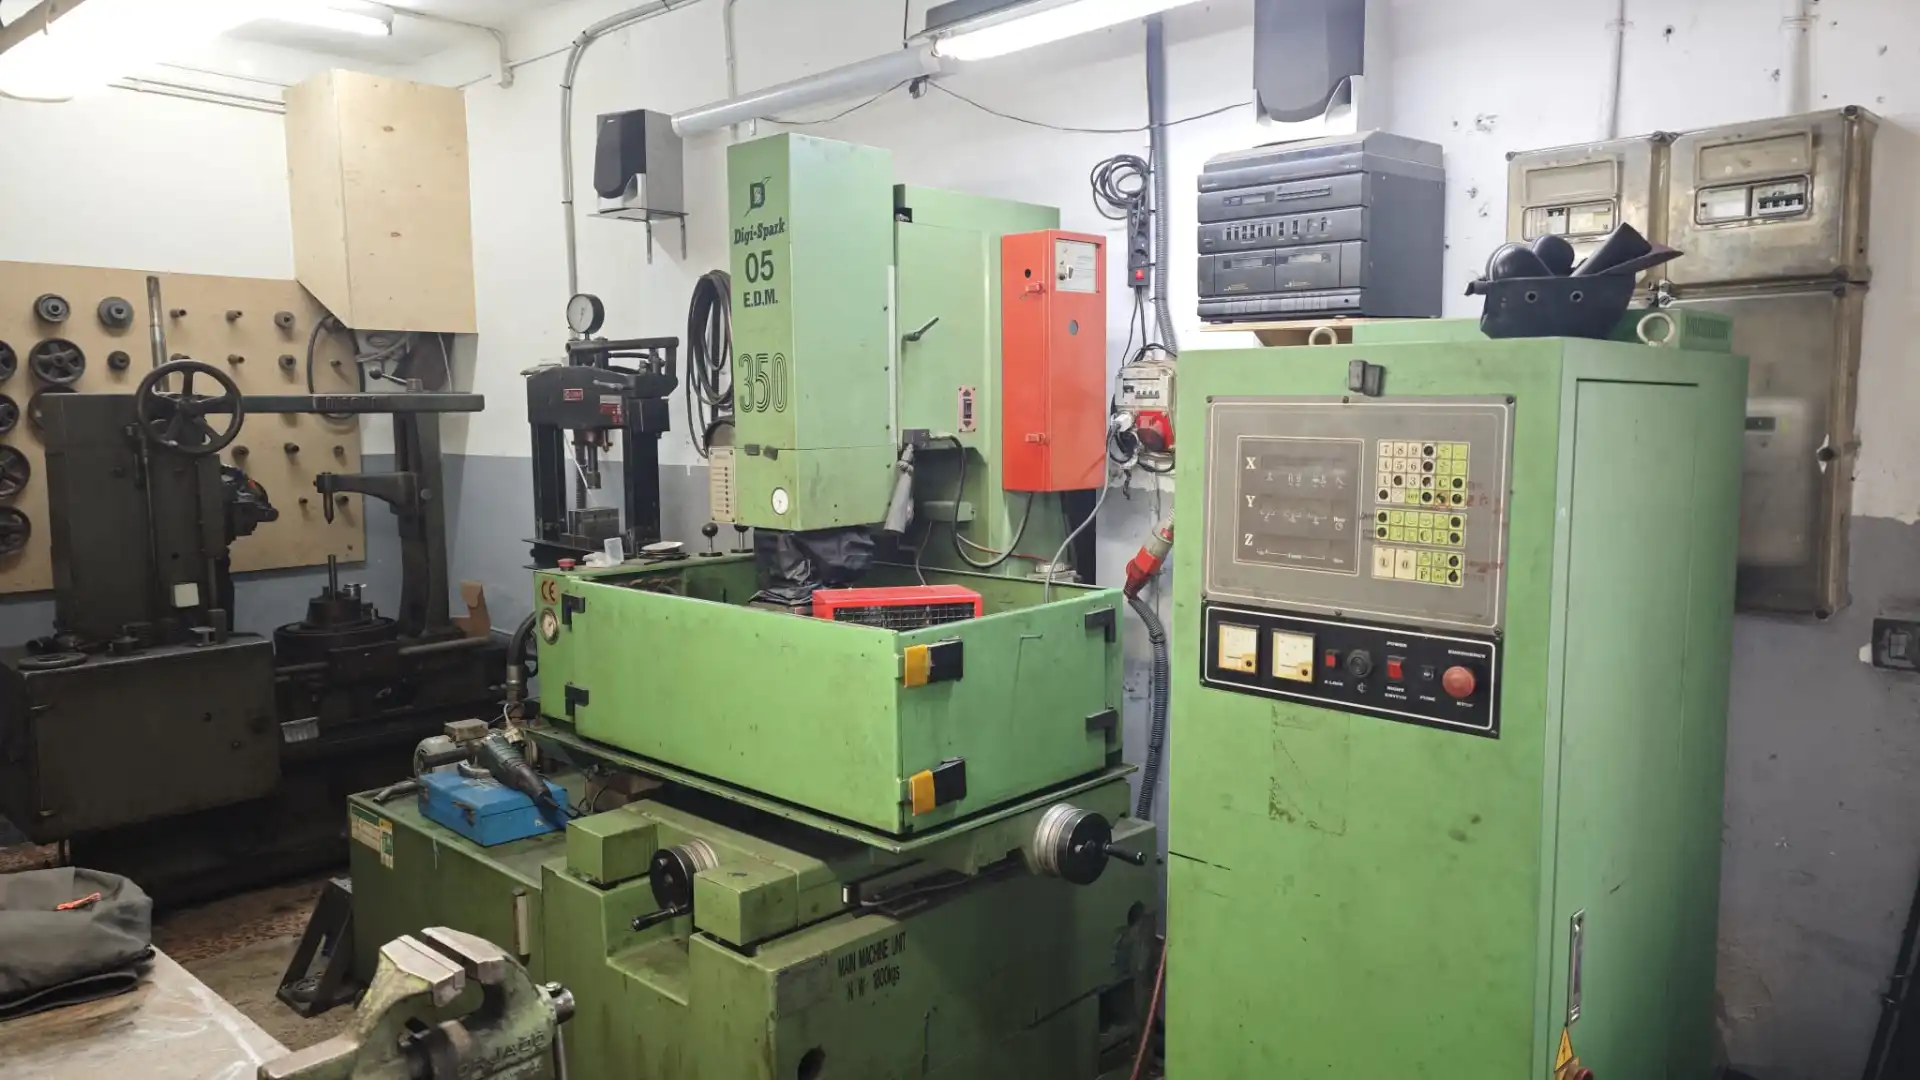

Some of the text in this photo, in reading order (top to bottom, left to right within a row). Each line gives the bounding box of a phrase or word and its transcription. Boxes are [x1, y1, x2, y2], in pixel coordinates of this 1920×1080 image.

[733, 217, 786, 245] Digi-Spark
[745, 249, 775, 283] 05
[743, 288, 779, 308] E.D.M.
[739, 352, 787, 413] 350
[1245, 457, 1256, 470] X
[1245, 494, 1256, 508] Y
[1244, 533, 1254, 546] Z
[838, 931, 906, 978] MAIN MACHINE UNIT
